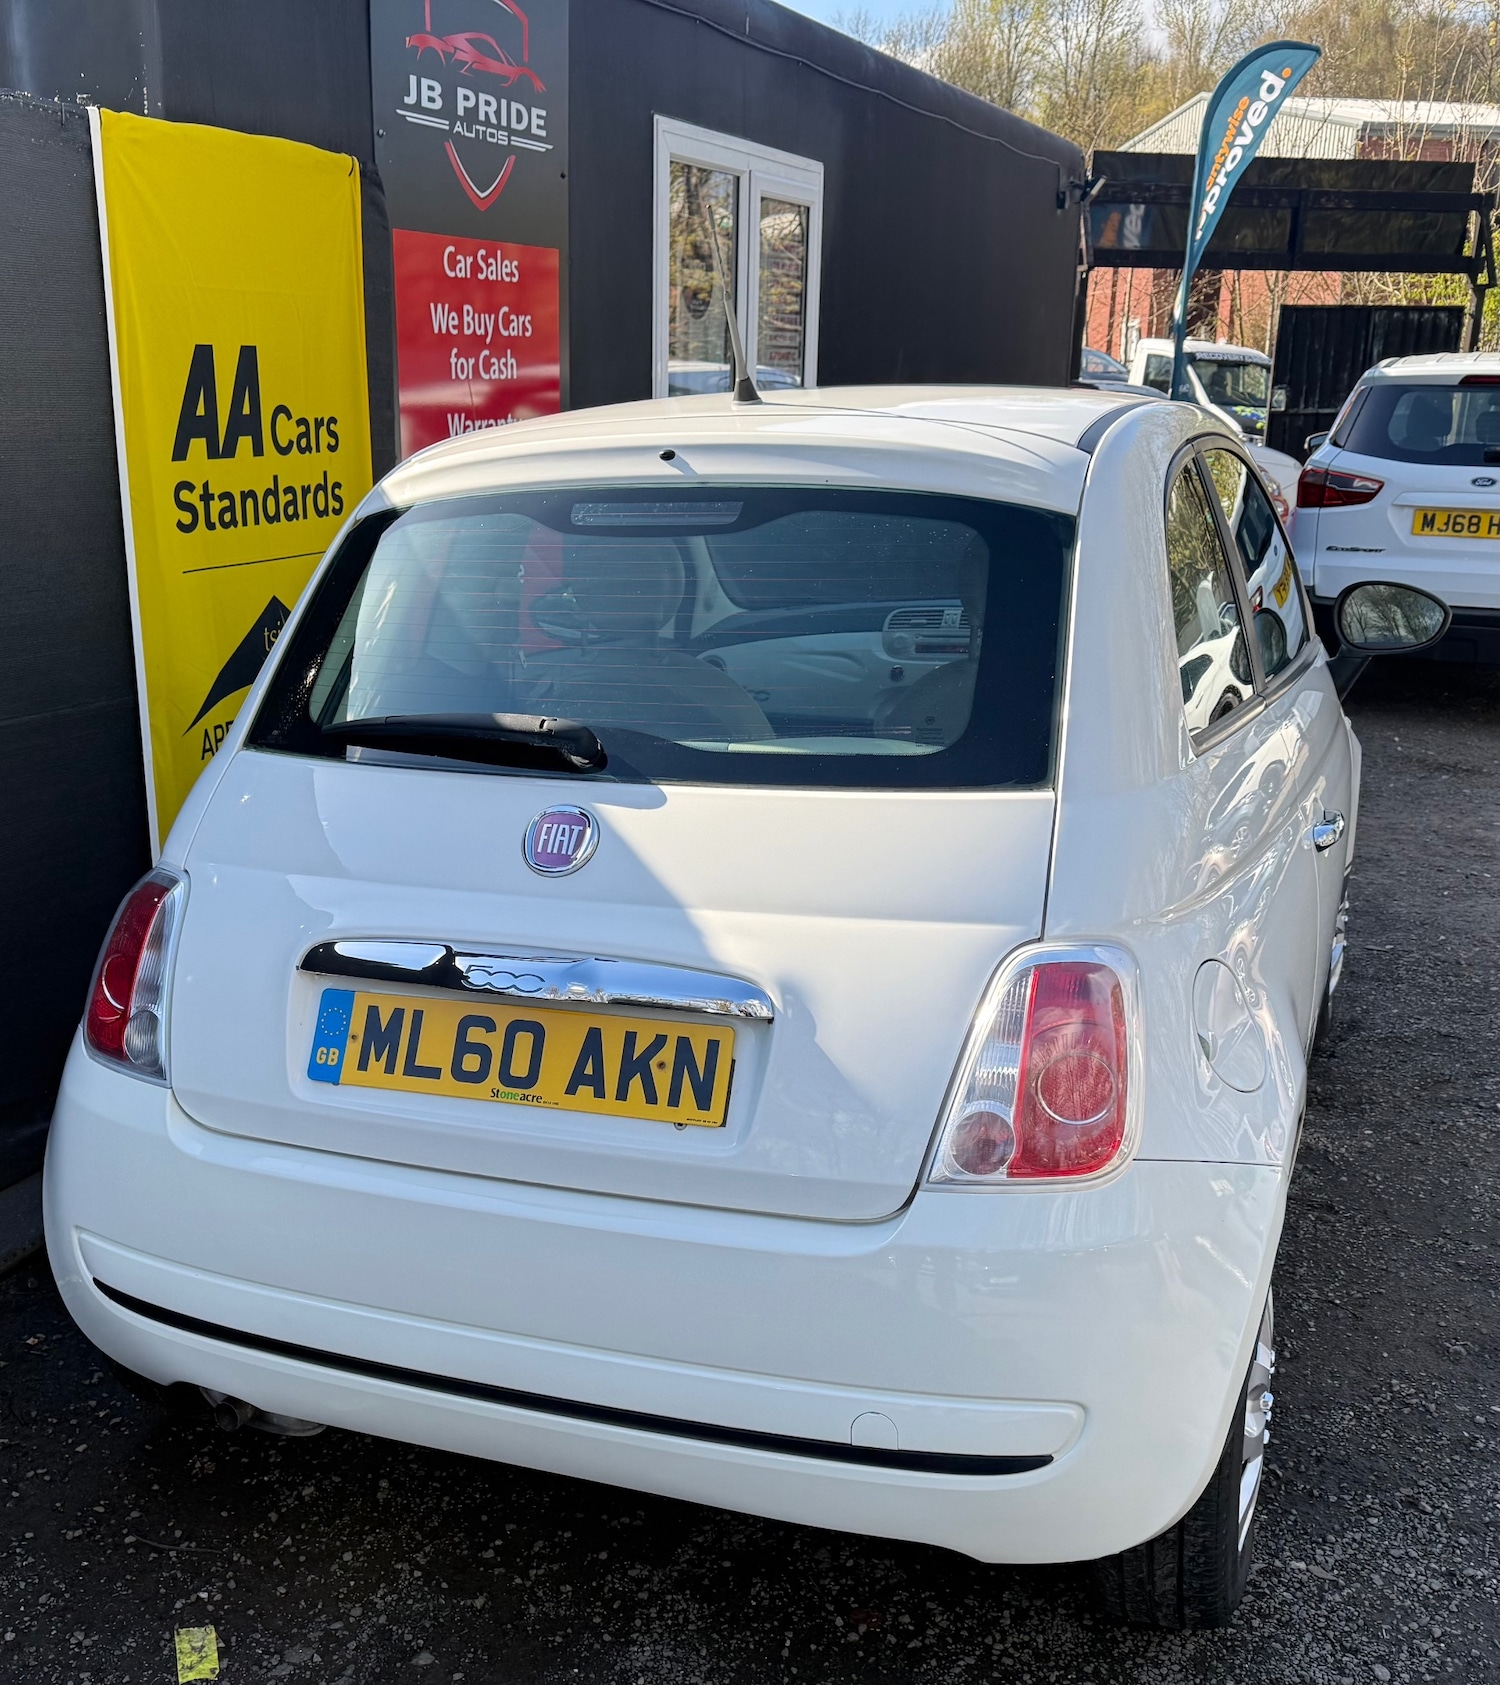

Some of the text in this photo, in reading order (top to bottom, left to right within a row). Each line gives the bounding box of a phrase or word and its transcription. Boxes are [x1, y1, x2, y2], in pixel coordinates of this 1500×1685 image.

[403, 74, 547, 138] JB PRIDE
[453, 120, 508, 146] AUTOS
[443, 245, 520, 283] Car Sales
[430, 302, 533, 345] We Buy Cars
[450, 347, 518, 380] for Cash
[171, 344, 339, 462] AA Cars
[173, 470, 344, 534] Standards
[1420, 512, 1482, 535] MJ68
[537, 822, 584, 857] FIAT
[461, 965, 546, 994] 500
[315, 1046, 340, 1066] GB
[356, 1004, 722, 1112] ML60 AKN
[490, 1087, 543, 1104] Stoneacre
